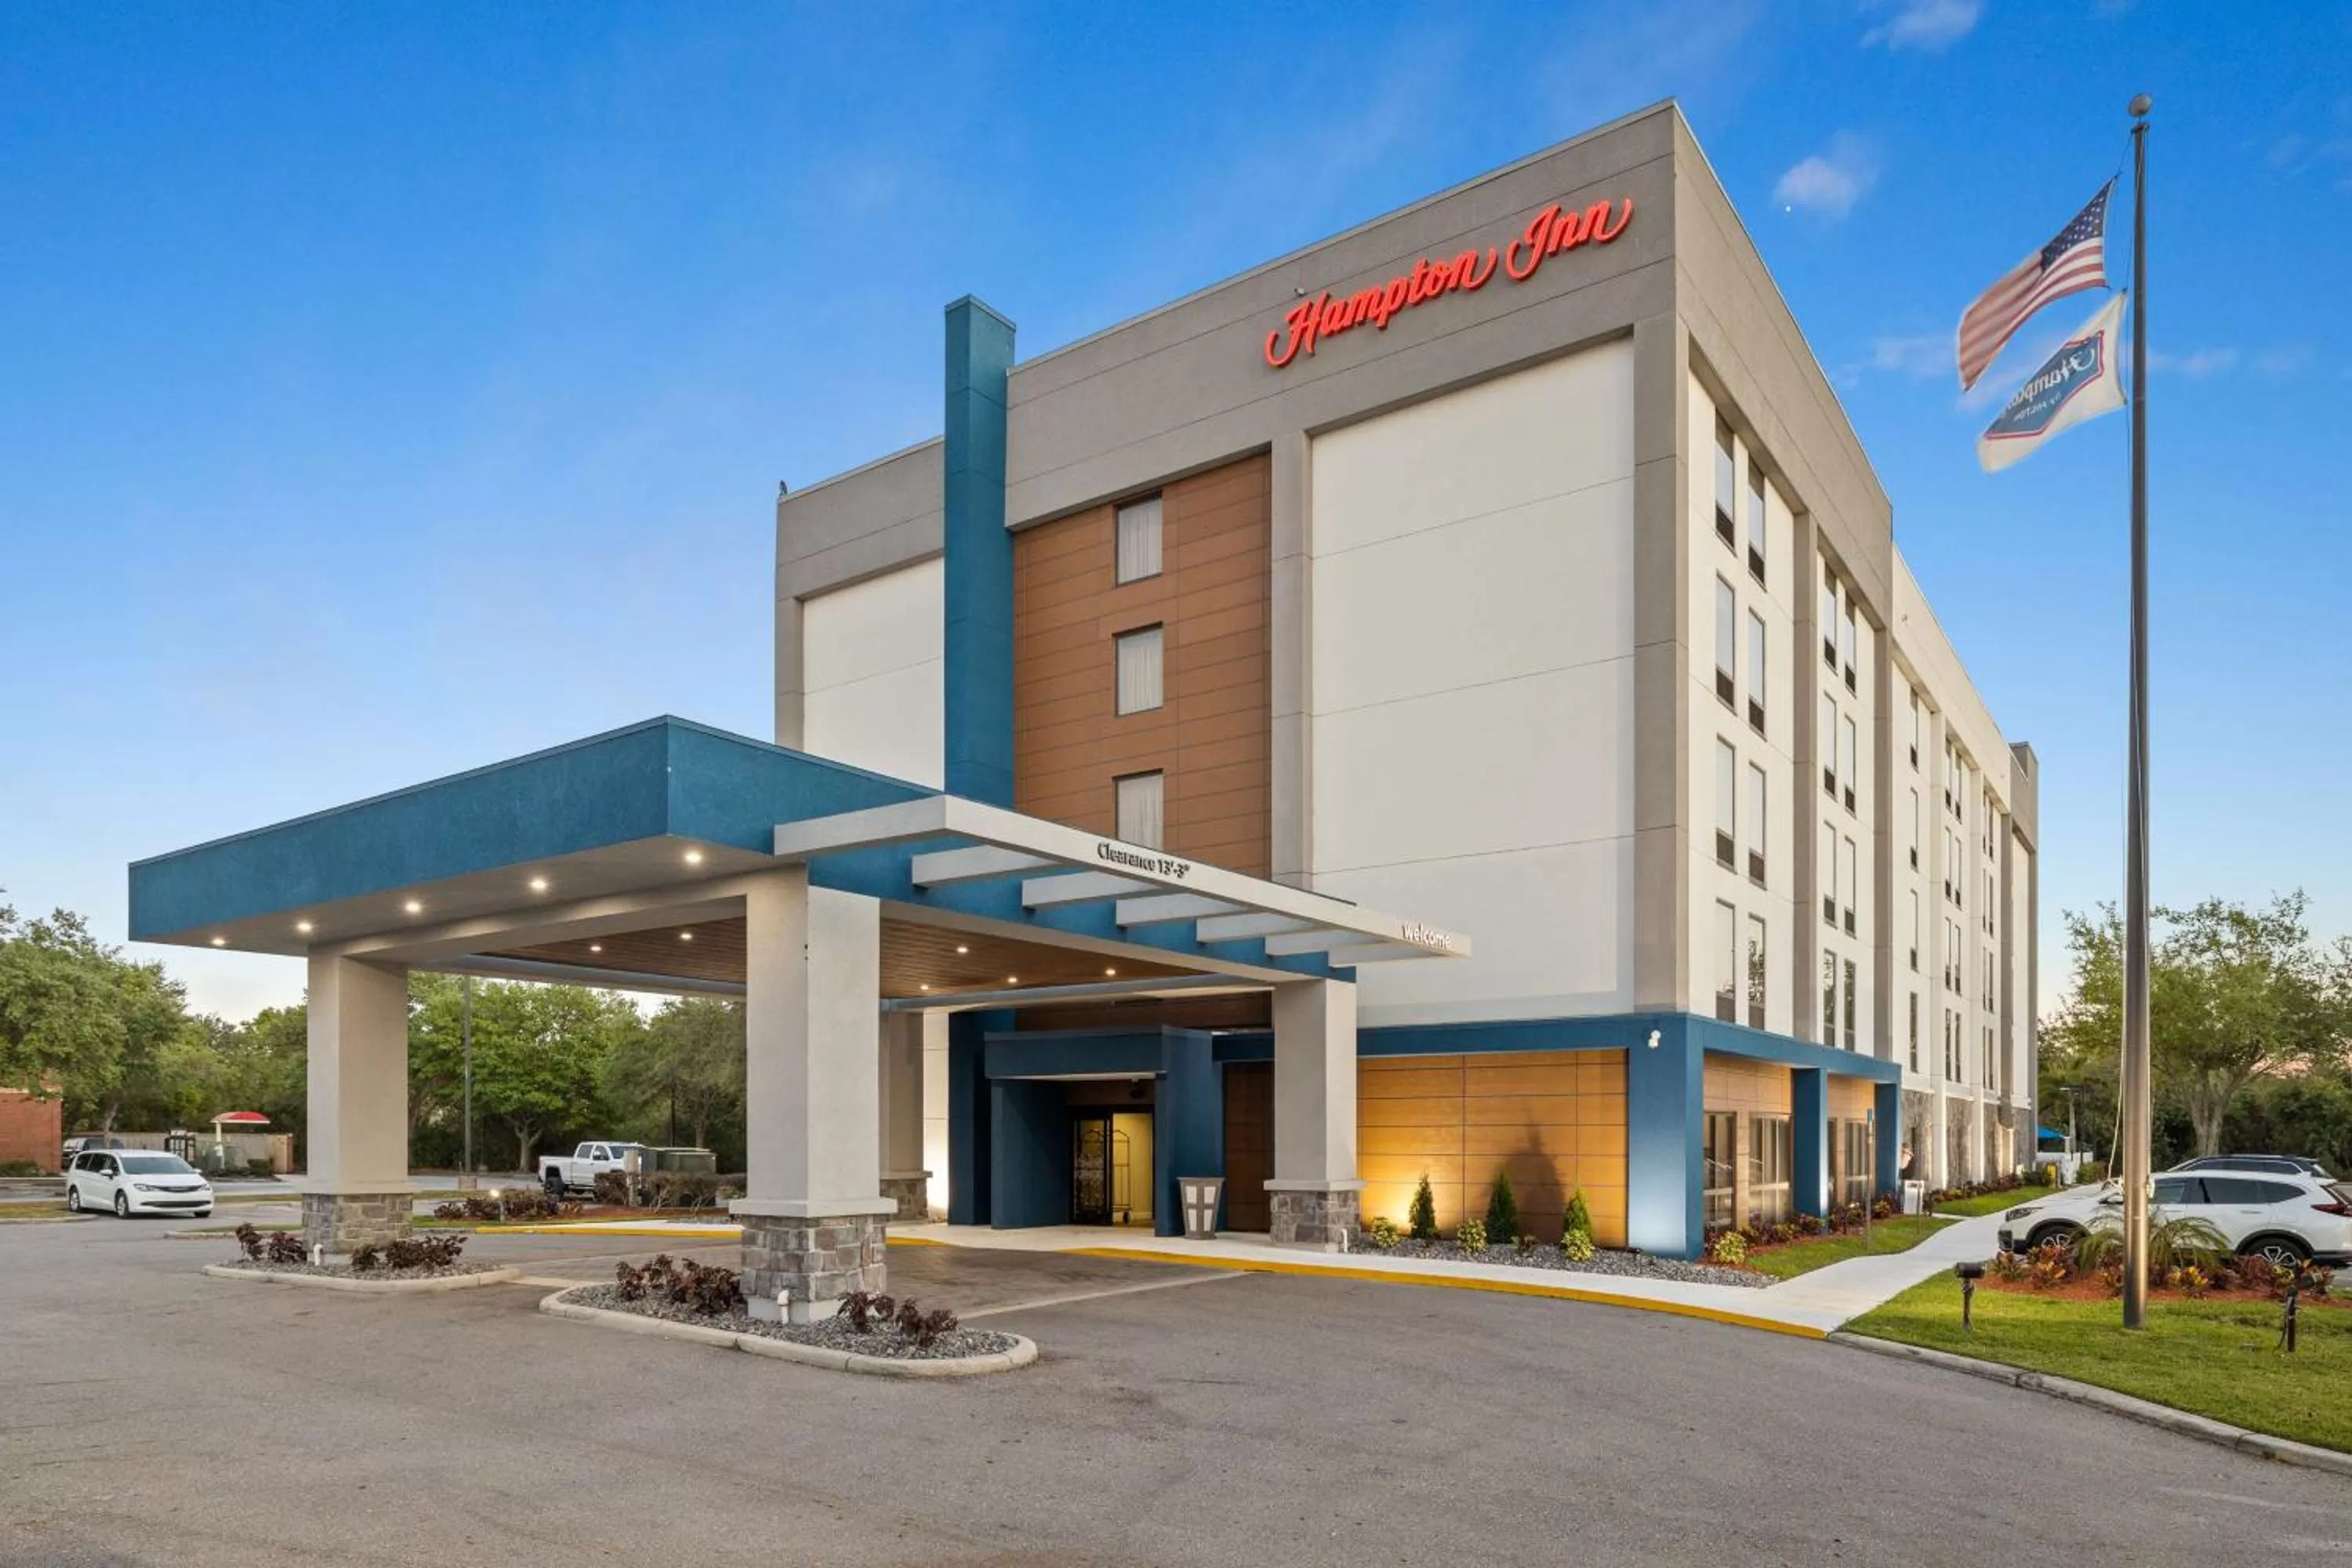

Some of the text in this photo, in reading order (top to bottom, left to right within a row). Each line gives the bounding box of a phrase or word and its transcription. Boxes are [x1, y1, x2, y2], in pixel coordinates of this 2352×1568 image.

[1264, 198, 1634, 368] Hampton Inn
[1097, 842, 1156, 872] Clearance
[1401, 923, 1451, 949] Welcome
